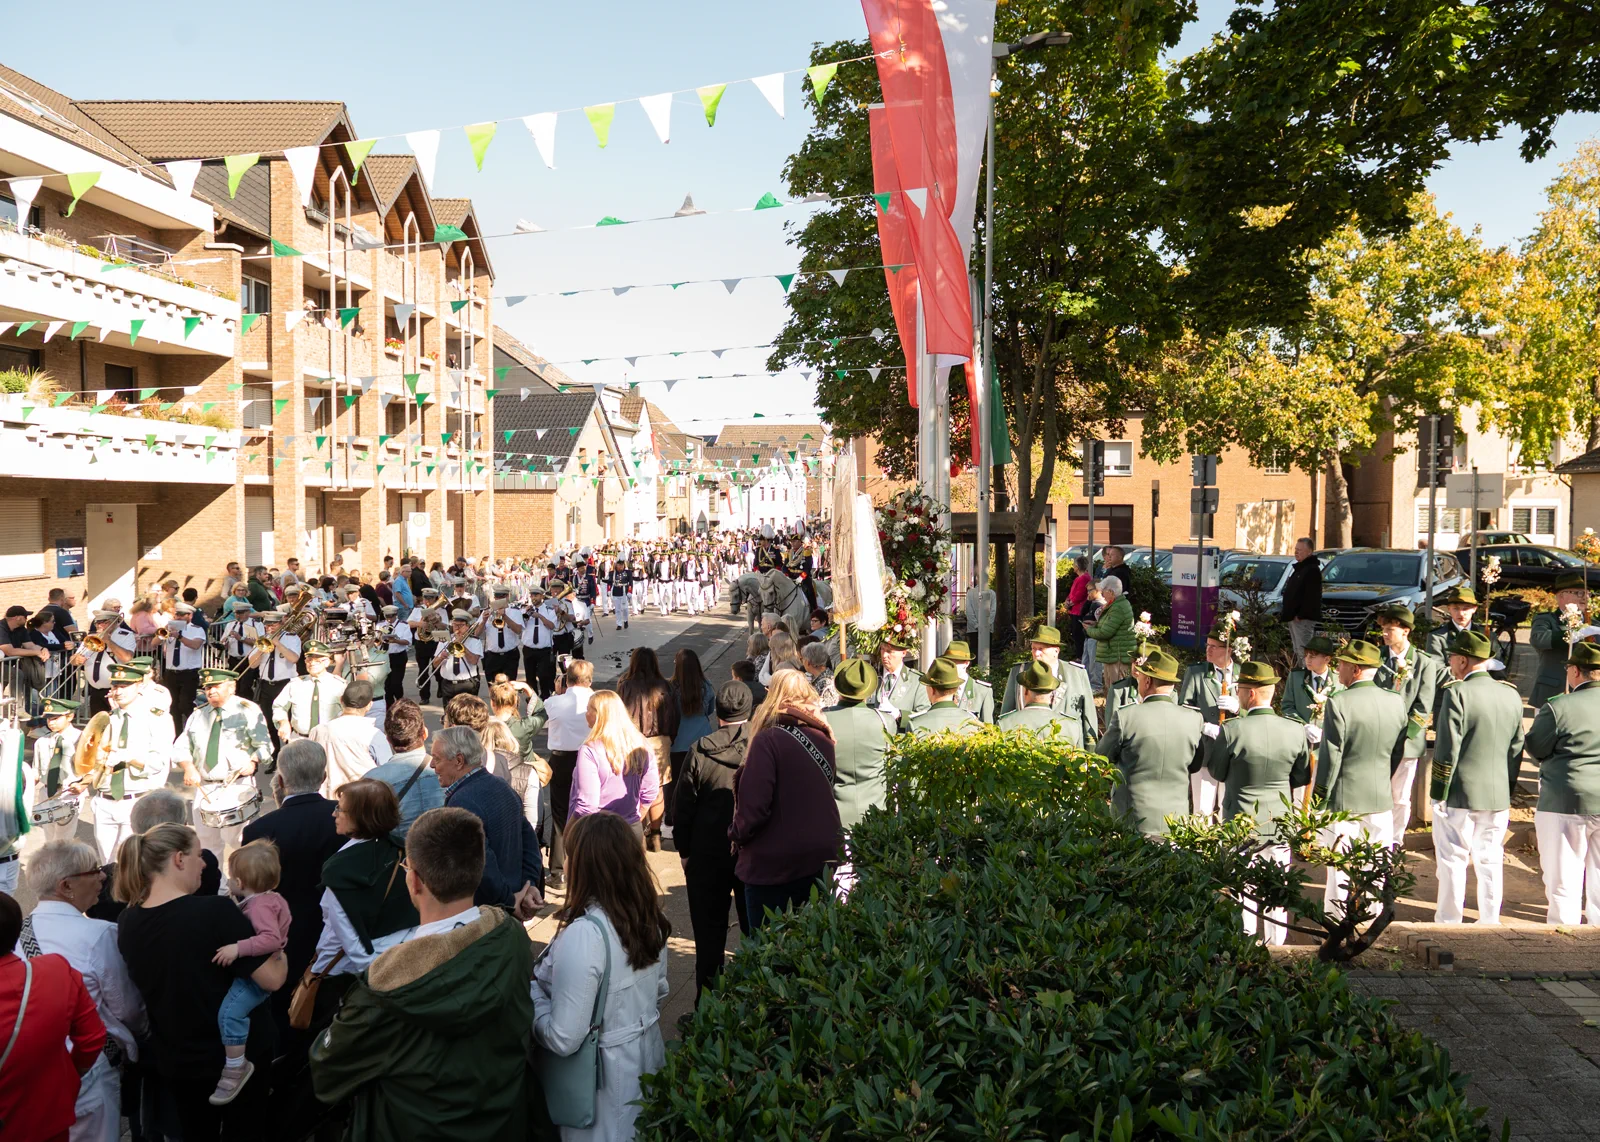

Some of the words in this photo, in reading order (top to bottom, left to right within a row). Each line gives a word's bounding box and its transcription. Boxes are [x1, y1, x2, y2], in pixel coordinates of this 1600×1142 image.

[1181, 572, 1197, 580] NEW
[791, 728, 809, 746] LOVE
[808, 745, 824, 764] LOVE
